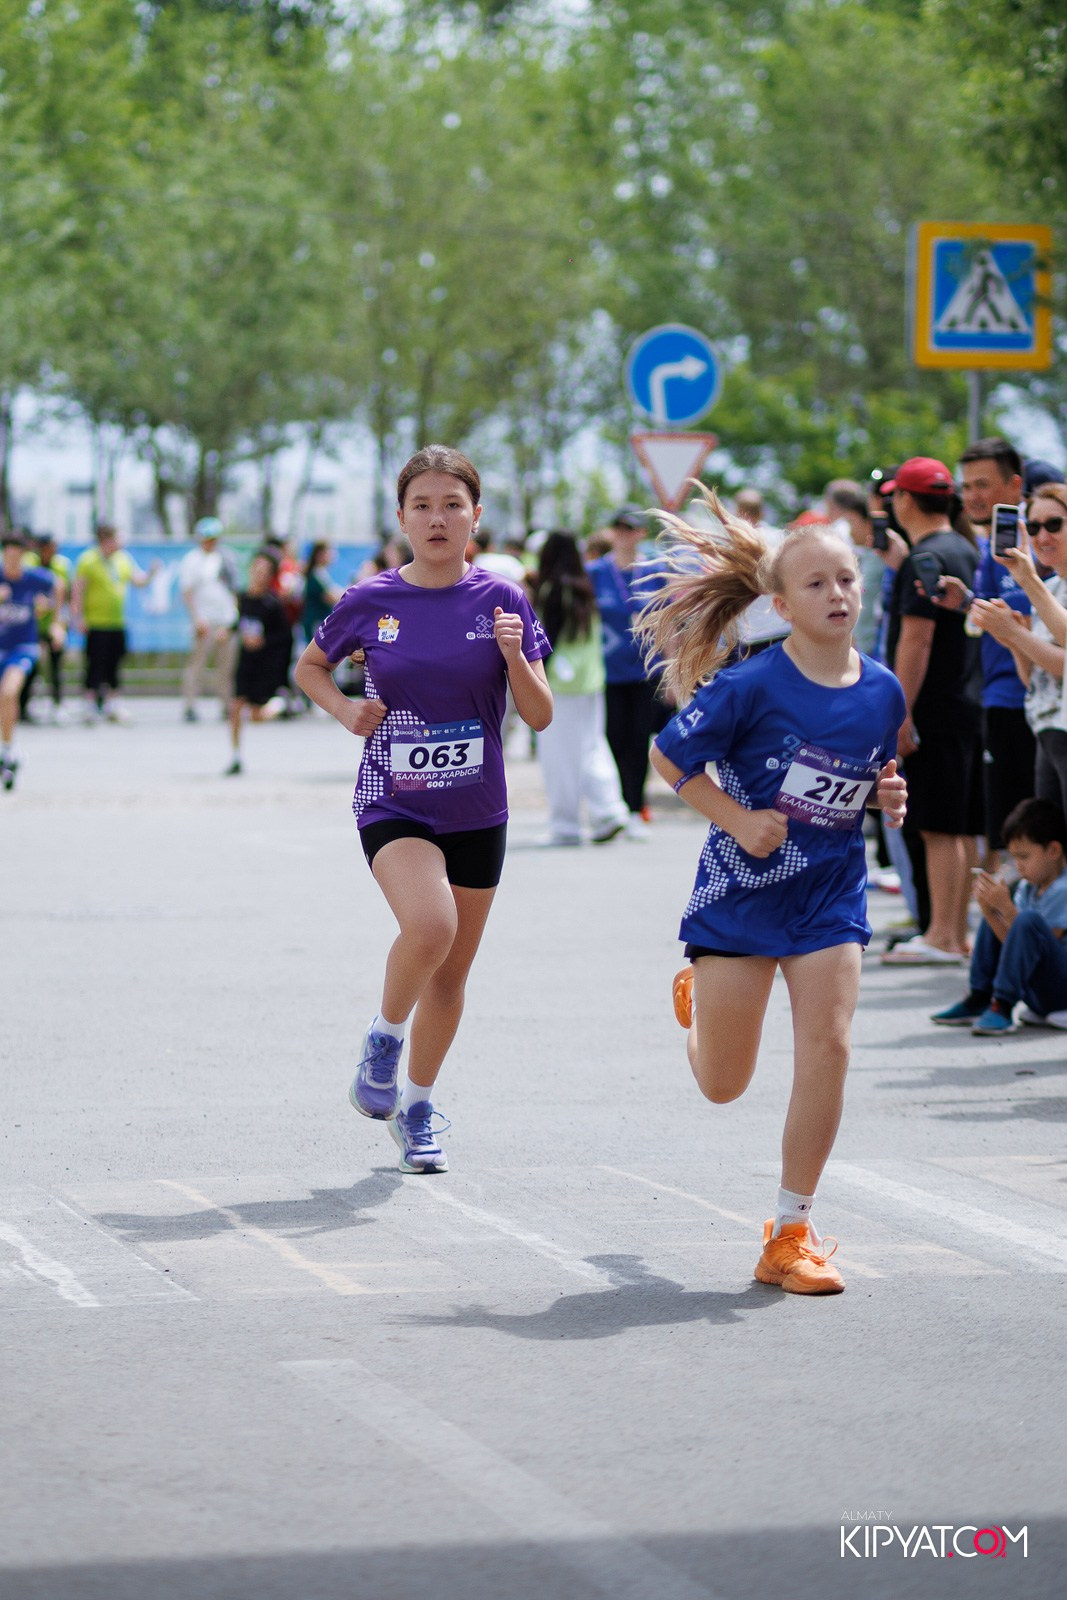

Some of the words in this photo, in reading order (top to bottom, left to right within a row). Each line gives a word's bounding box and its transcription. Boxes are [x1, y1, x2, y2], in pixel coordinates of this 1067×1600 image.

[408, 743, 470, 770] 063
[395, 772, 438, 781] БАЛАЛАР
[440, 767, 480, 779] ЖАРЫСЫ
[426, 780, 445, 789] 600
[803, 775, 862, 808] 214
[780, 795, 827, 815] БАЛАЛАР
[826, 809, 857, 820] ЖАРЫСЫ
[810, 815, 828, 825] 600
